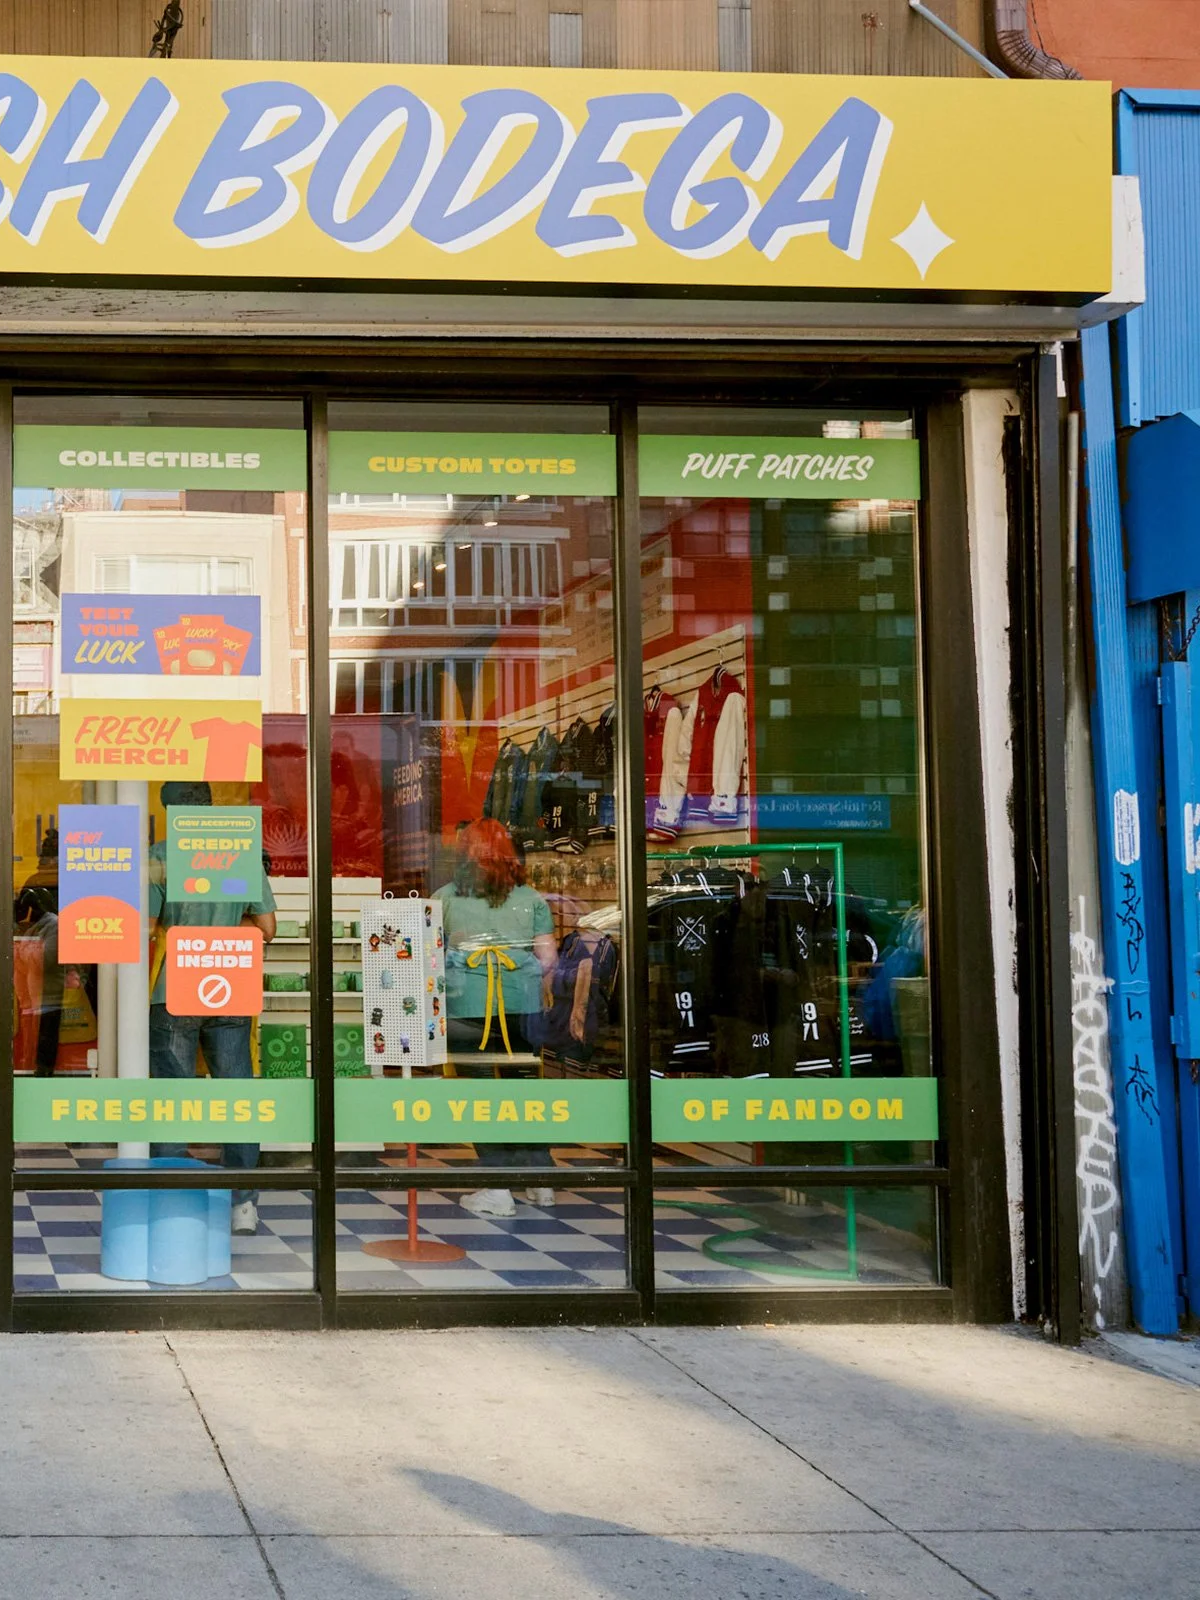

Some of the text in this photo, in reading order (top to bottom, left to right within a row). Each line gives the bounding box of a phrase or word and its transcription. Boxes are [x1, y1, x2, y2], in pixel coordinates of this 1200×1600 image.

[172, 79, 893, 262] BODEGA
[58, 450, 261, 469] COLLECTIBLES
[368, 456, 576, 475] CUSTOM TOTES
[682, 453, 875, 481] PUFF PATCHES
[80, 607, 134, 621] TEST
[78, 624, 139, 637] YOUR
[185, 627, 218, 638] LUCKY
[74, 640, 145, 664] LUCK
[73, 716, 181, 746] FRESH
[75, 748, 189, 765] MERCH
[393, 761, 422, 785] FEEDING
[393, 782, 422, 807] AMERICA
[178, 819, 251, 827] NOW ACCEPTING
[178, 838, 253, 851] CREDIT
[66, 847, 132, 862] PUFF
[191, 851, 240, 870] ONLY
[66, 862, 131, 872] PATCHES
[75, 917, 124, 934] 10X
[176, 939, 253, 952] NO ATM
[176, 954, 253, 969] INSIDE
[675, 991, 693, 1010] 19
[801, 1002, 817, 1021] 19
[752, 1033, 770, 1048] 218
[803, 1023, 819, 1041] 71
[52, 1099, 276, 1122] FRESHNESS
[392, 1100, 571, 1122] 10 YEARS
[683, 1098, 904, 1122] OF FANDOM
